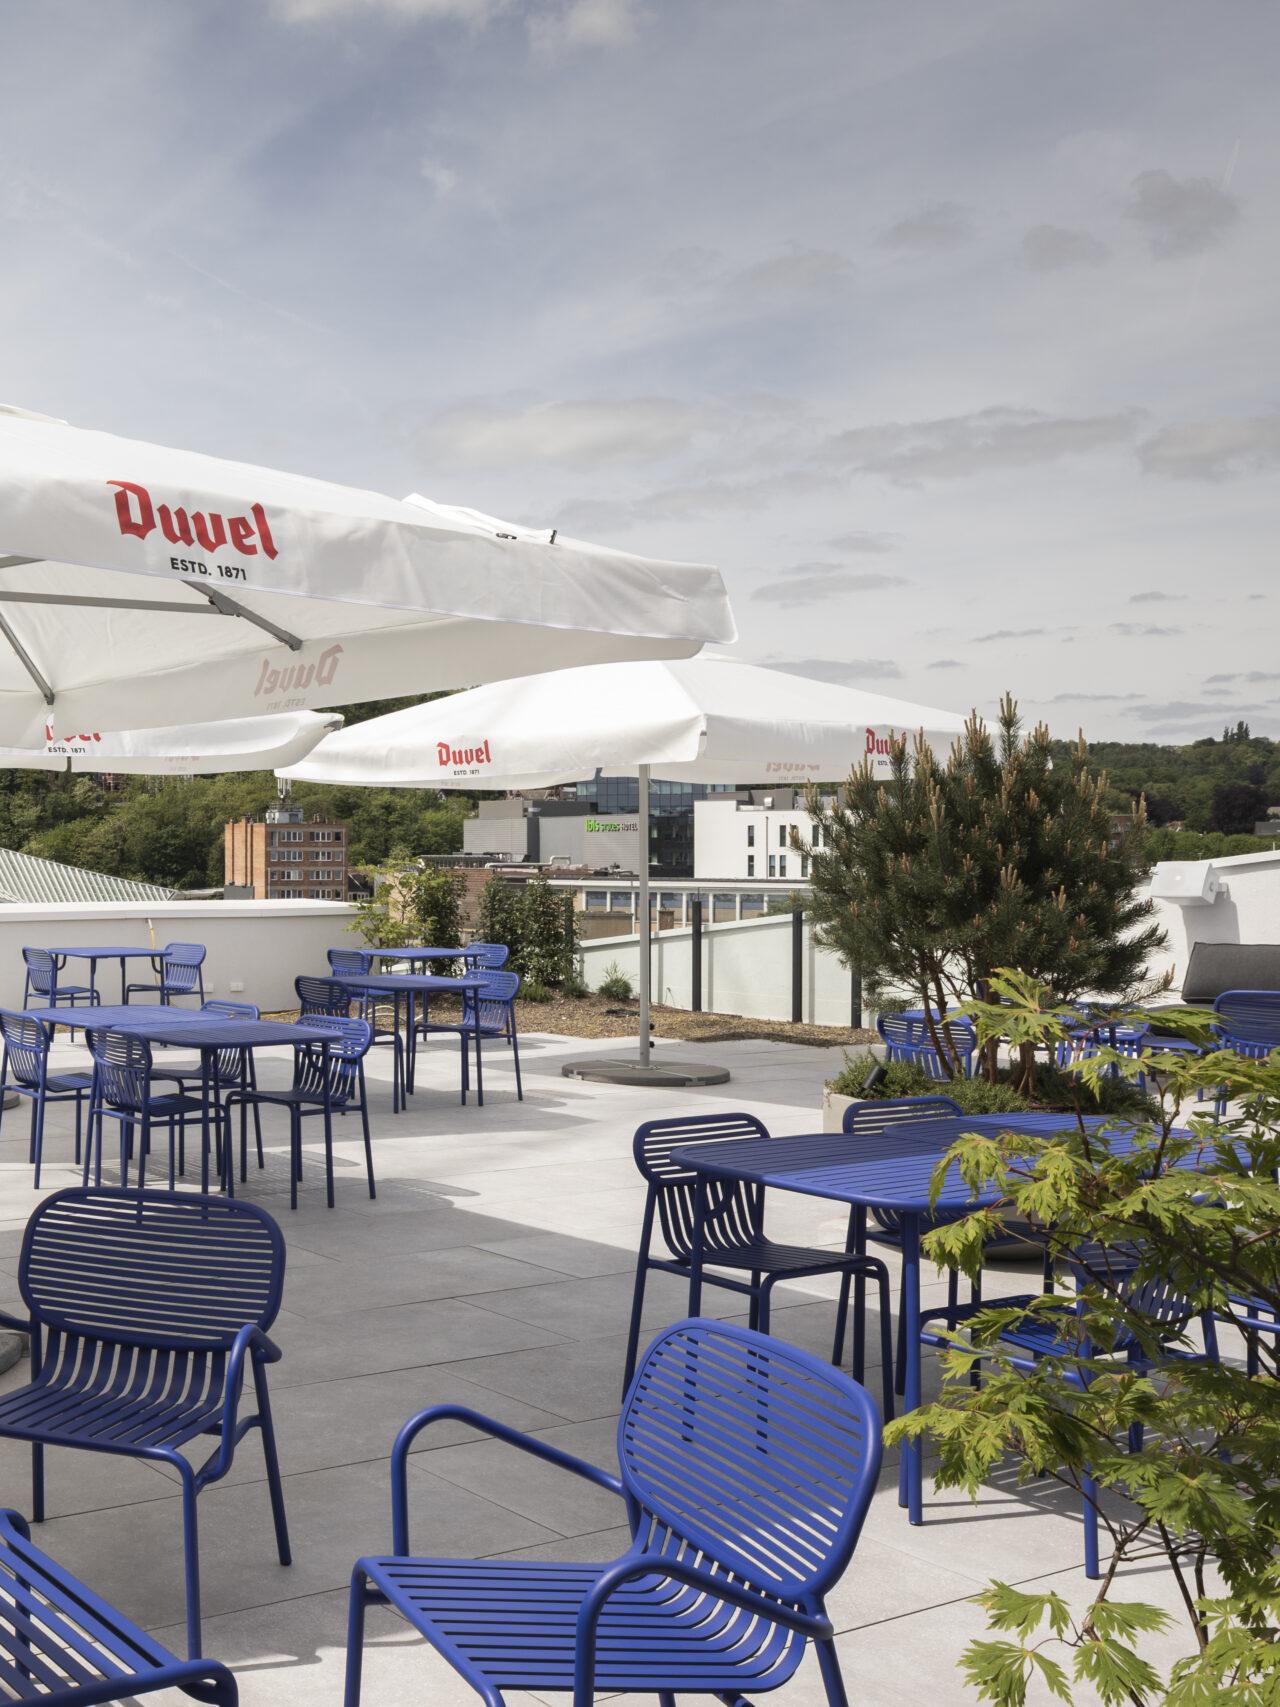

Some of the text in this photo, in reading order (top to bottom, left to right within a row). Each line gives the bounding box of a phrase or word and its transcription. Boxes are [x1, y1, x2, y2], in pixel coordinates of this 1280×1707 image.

[106, 480, 279, 561] Duvel
[170, 557, 247, 581] ESTD. 1871
[436, 739, 492, 767] Duvel
